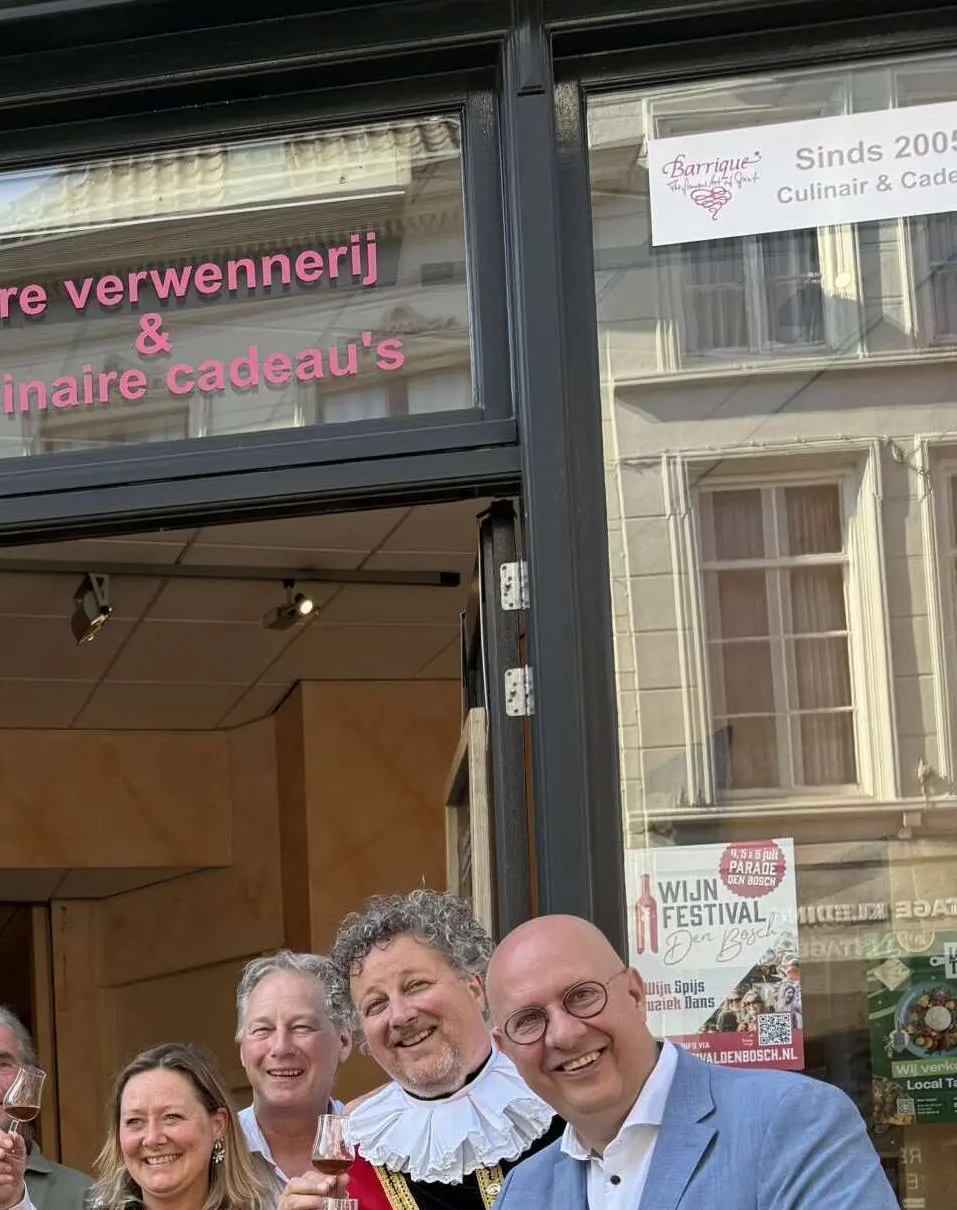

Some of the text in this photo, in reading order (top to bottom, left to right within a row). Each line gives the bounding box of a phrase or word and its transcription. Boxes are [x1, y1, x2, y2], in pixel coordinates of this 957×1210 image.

[661, 153, 762, 178] Barrique
[795, 140, 884, 171] Sinds
[777, 177, 869, 204] Culinair
[876, 174, 893, 192] &
[63, 230, 379, 311] verwennerij
[134, 311, 173, 356] &
[164, 330, 406, 397] cadeau's
[727, 874, 776, 887] DEN BOSCH
[729, 860, 778, 876] PARADE
[658, 878, 719, 904] WIJN
[662, 901, 767, 929] FESTIVAL
[663, 911, 778, 966] Den Bosch
[674, 979, 705, 996] Spijs
[646, 996, 715, 1012] uziek Dans
[691, 1048, 798, 1065] VALDENBOSCH.NL
[699, 1041, 711, 1050] VIA
[907, 1077, 943, 1091] Local
